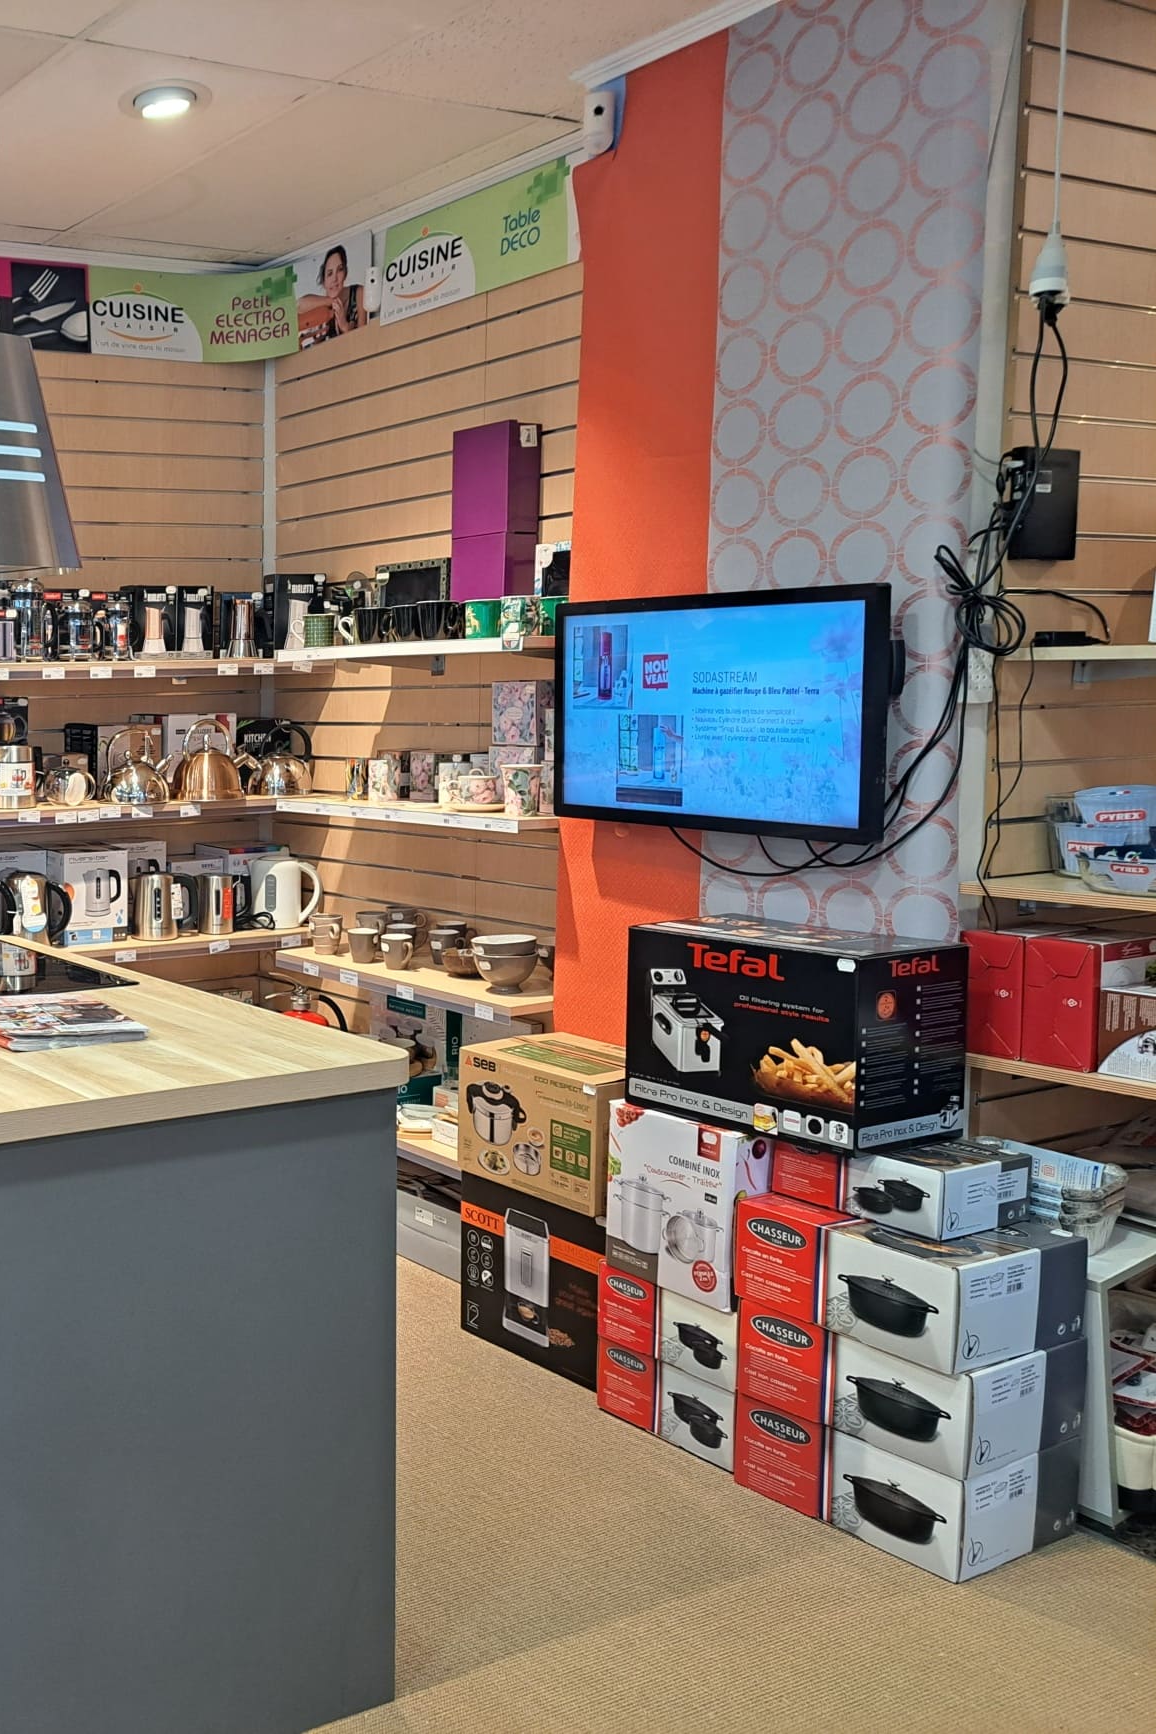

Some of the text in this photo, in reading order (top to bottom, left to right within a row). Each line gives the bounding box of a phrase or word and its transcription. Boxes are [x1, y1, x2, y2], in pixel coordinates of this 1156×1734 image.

[503, 208, 541, 233] Table
[500, 226, 541, 256] DECO
[386, 236, 463, 282] CUISINE
[92, 300, 184, 323] CUISINE
[231, 295, 271, 311] Petit
[215, 307, 286, 328] ELECTRO
[209, 322, 290, 345] MENAGER
[692, 671, 758, 684] SODASTREAM
[1099, 811, 1141, 821] PYREX
[687, 942, 785, 982] Tefal
[887, 954, 941, 978] Tefal
[659, 1090, 678, 1101] Pro
[679, 1093, 699, 1107] Inox
[713, 1104, 748, 1120] Design
[702, 1166, 721, 1179] INOX
[465, 1207, 500, 1230] SCOTT
[750, 1222, 802, 1246] CHASSEUR
[609, 1278, 644, 1297] CHASSEUR
[755, 1319, 809, 1346] CHASSEUR
[609, 1350, 644, 1371] CHASSEUR
[753, 1413, 807, 1442] CHASSEUR
